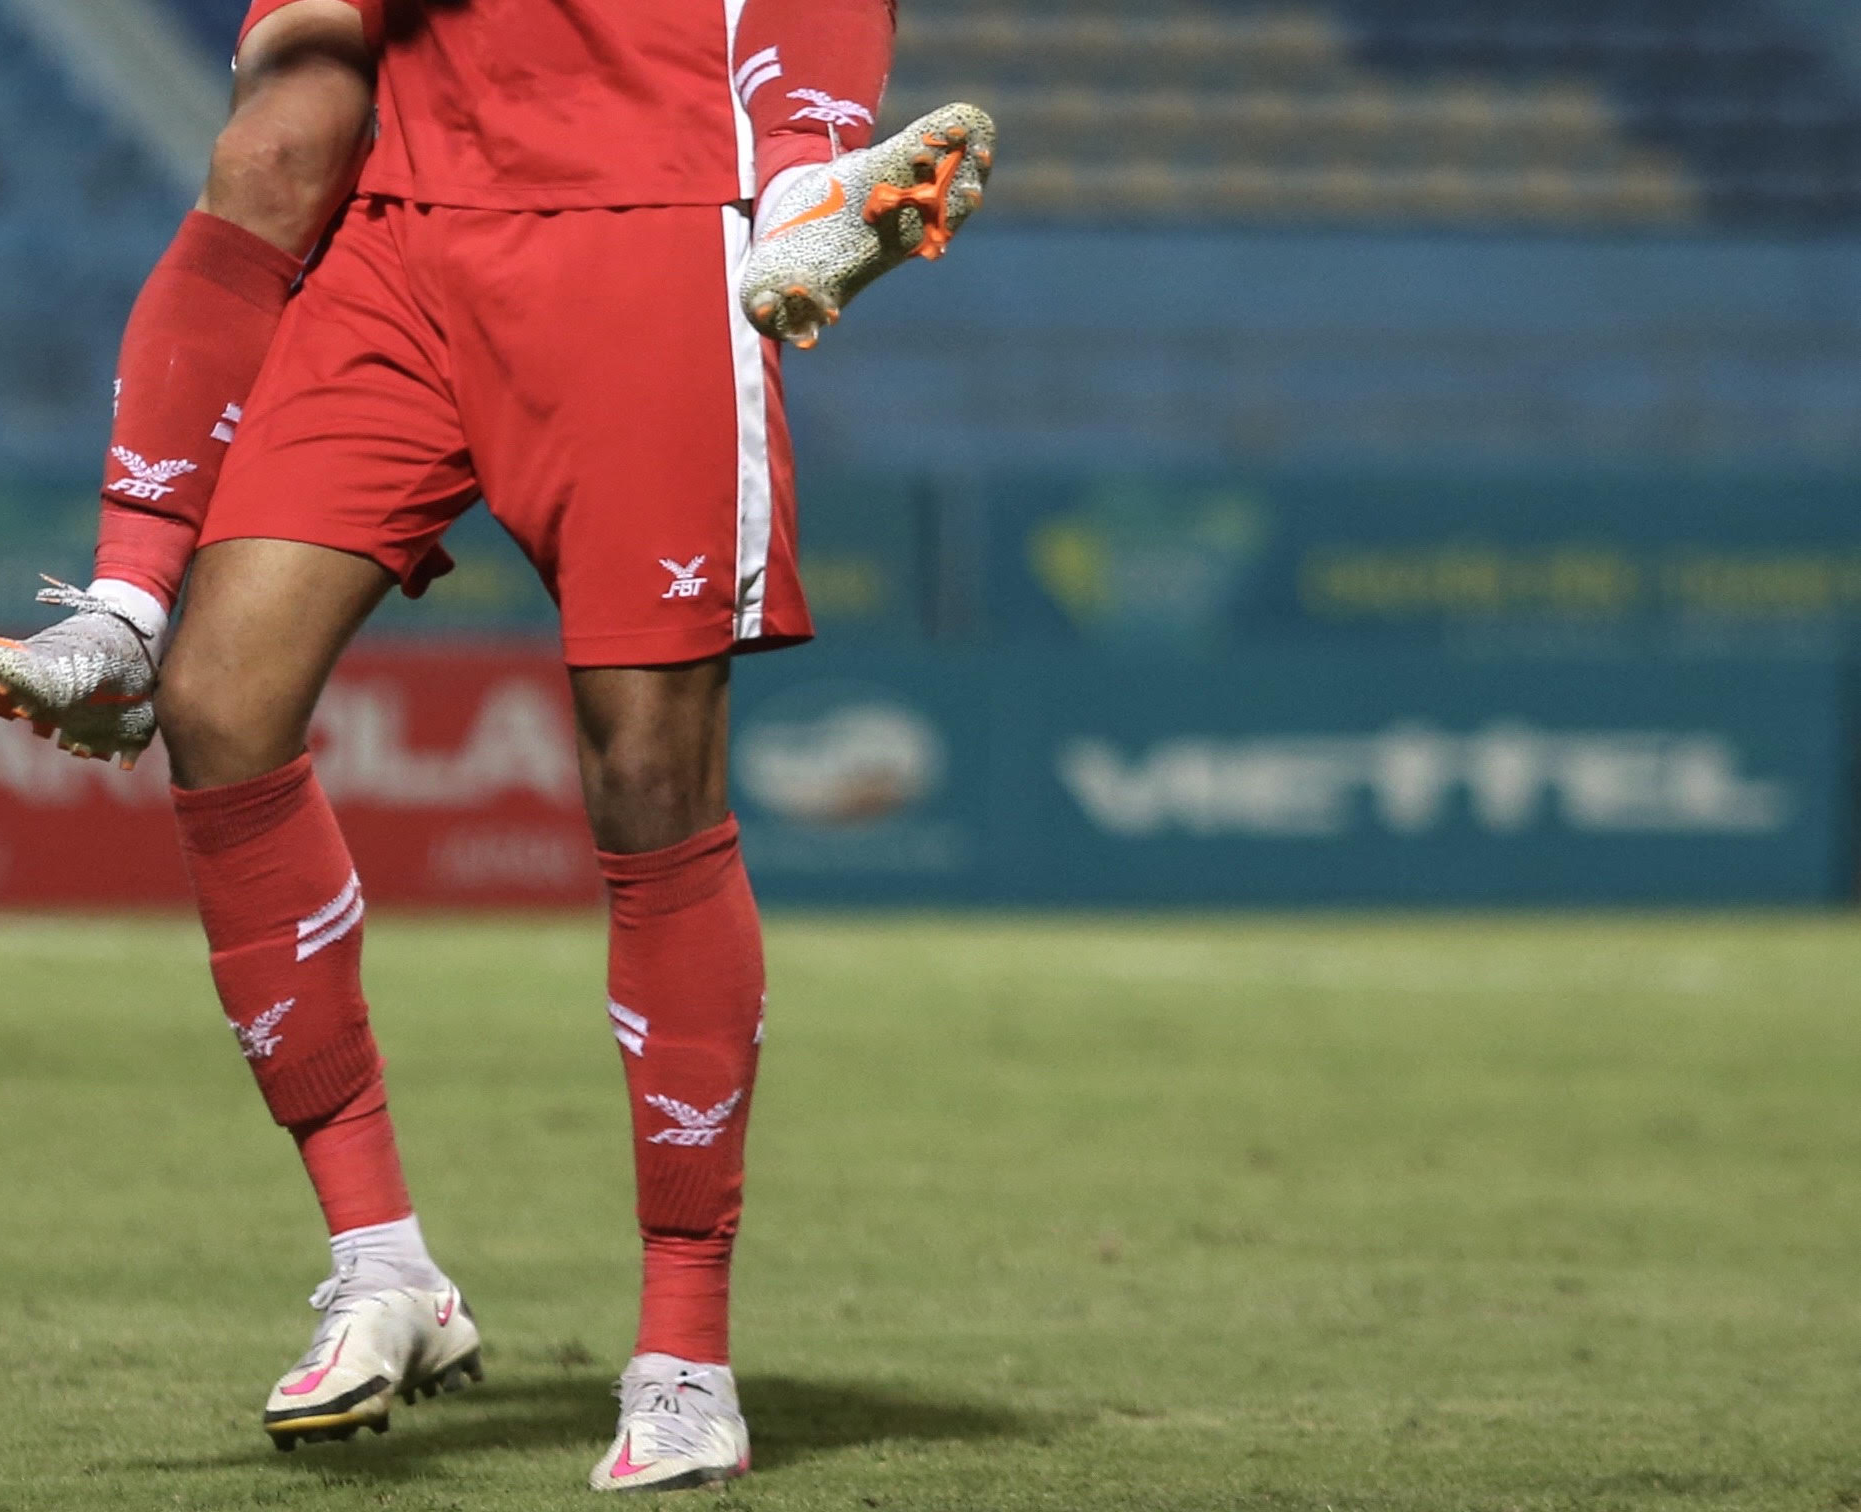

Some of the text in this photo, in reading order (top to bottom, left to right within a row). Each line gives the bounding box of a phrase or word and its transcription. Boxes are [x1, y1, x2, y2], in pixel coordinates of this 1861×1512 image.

[106, 478, 175, 501] FBT
[661, 577, 708, 599] FBT
[1060, 731, 1785, 834] VIETTEL
